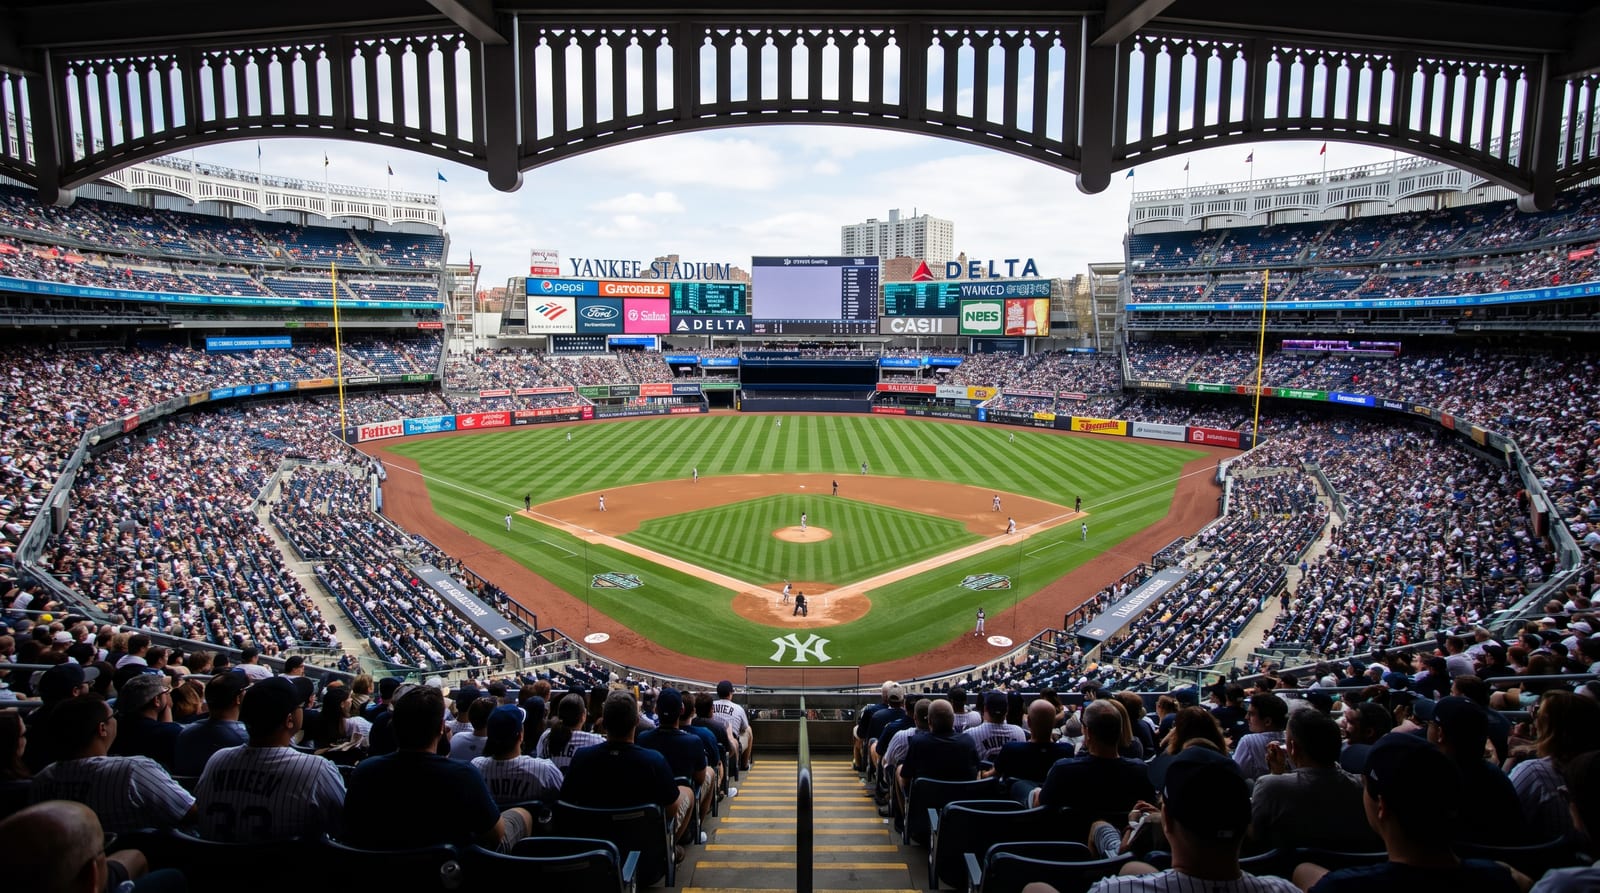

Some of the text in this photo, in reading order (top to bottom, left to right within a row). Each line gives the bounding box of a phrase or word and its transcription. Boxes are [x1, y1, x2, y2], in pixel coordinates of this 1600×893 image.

[569, 258, 731, 280] YANKEE STADIUM
[946, 258, 1039, 279] DELTA
[555, 282, 584, 293] pepsi
[587, 307, 612, 318] Ford
[693, 319, 745, 330] DELTA
[769, 633, 832, 663] NY
